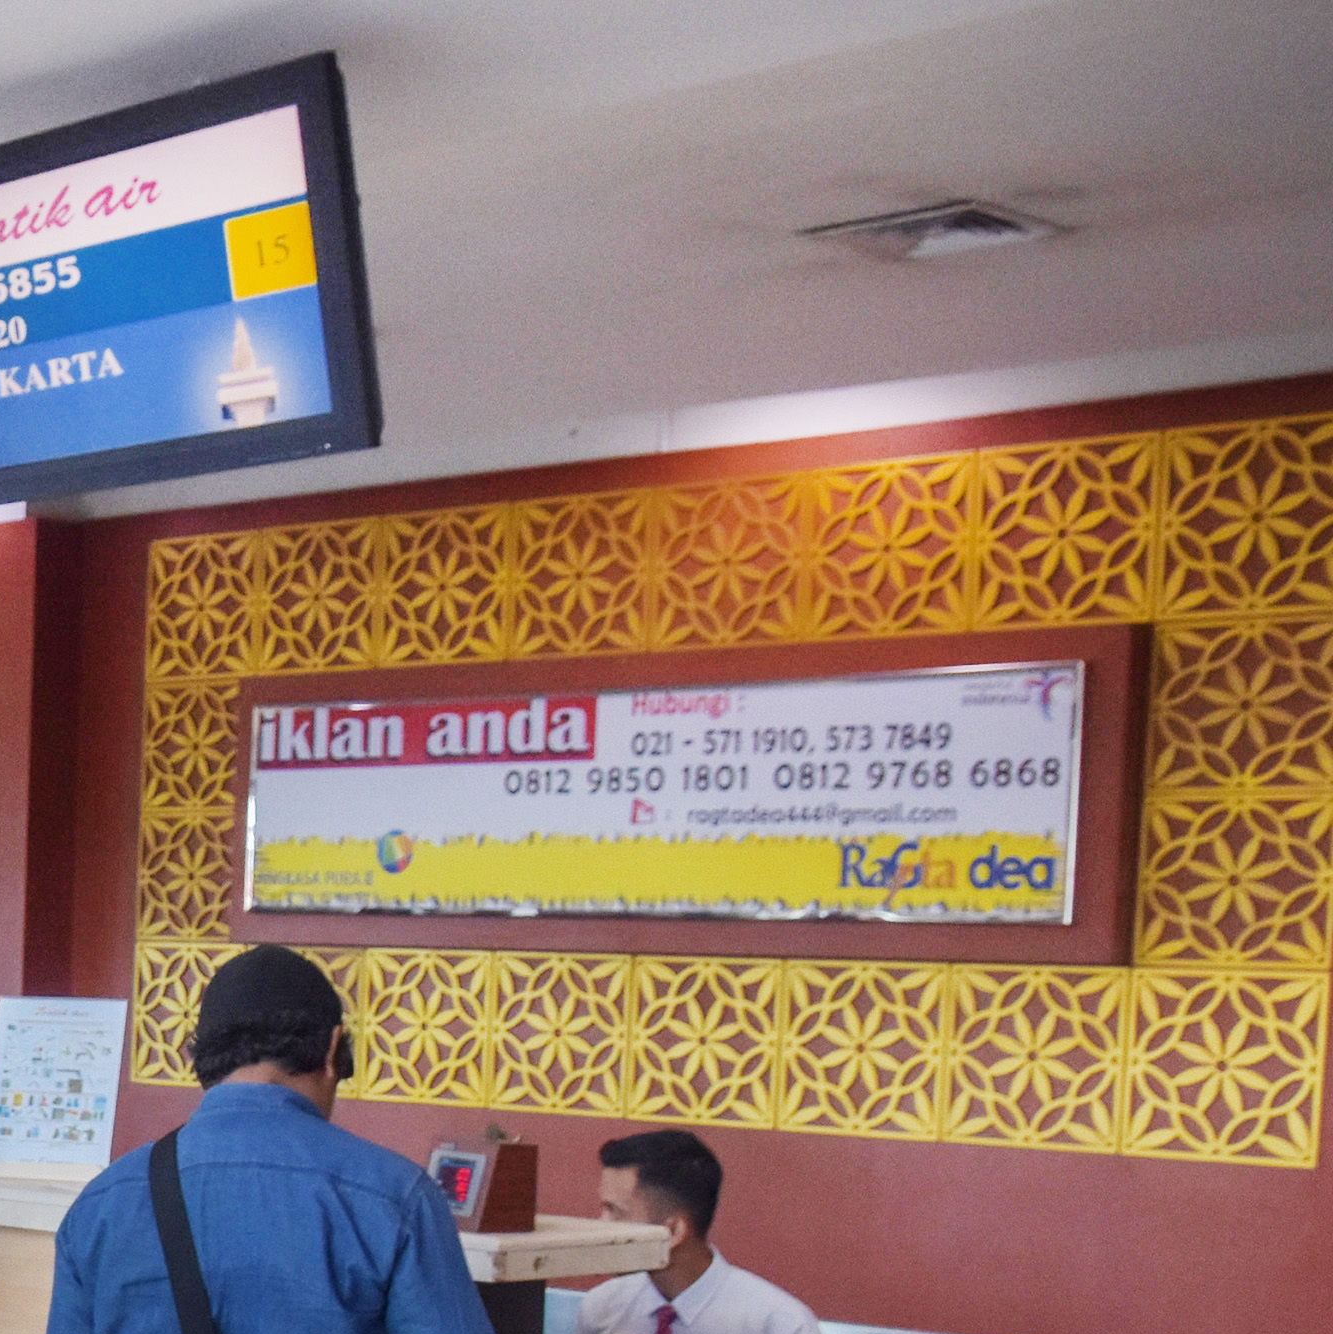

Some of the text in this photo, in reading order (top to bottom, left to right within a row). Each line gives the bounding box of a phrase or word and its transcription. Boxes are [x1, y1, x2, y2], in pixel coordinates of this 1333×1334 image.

[254, 235, 290, 267] 15
[259, 698, 591, 763] iklan anda
[632, 731, 673, 756] 021
[704, 730, 741, 755] 571
[826, 725, 874, 751] 573
[885, 723, 953, 750] 7849
[504, 757, 1062, 795] 0812 9850 1801 0812 9768 6868
[969, 844, 1057, 890] dea
